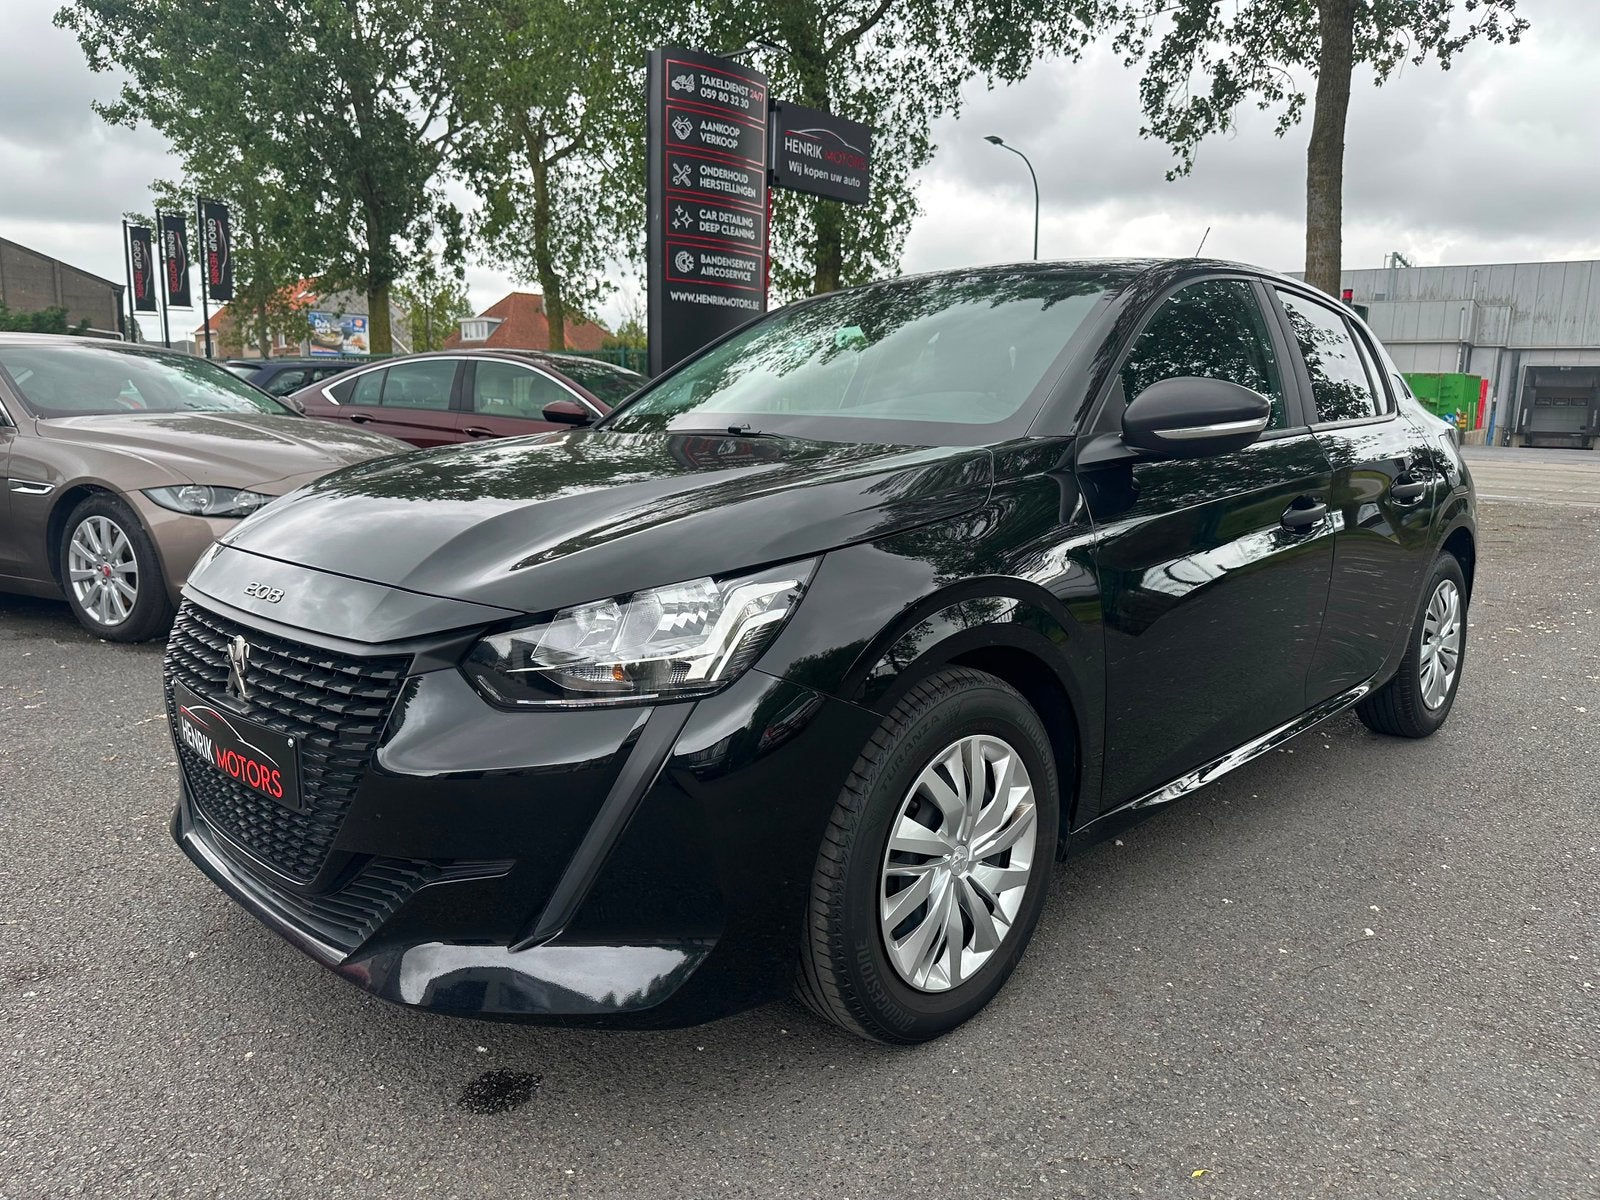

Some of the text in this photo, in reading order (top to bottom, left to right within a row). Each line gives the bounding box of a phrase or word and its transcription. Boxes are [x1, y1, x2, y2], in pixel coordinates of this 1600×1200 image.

[700, 74, 764, 102] TAKELDIENST 24/7
[700, 88, 749, 109] 059 80 32 30
[700, 120, 741, 138] AANKOOP
[700, 132, 738, 149] VERKOOP
[784, 137, 866, 171] HENRIK MOTORS
[700, 165, 749, 184] ONDERHOUD
[788, 160, 861, 188] Wij kopen uw auto
[700, 177, 756, 199] HERSTELLINGEN
[699, 209, 754, 228] CAR DETAILING
[207, 218, 217, 252] GROUP
[700, 222, 755, 241] DEEP CLEANING
[132, 240, 142, 269] GROUP
[166, 230, 178, 293] HENRIK MOTORS
[700, 255, 757, 272] BANDENSERVICE
[700, 266, 751, 281] AIRCOSERVICE
[670, 291, 760, 310] WWW.HENRIKMOTORS.BE
[243, 581, 285, 603] 208
[181, 715, 283, 799] HENRIK MOTORS
[878, 713, 941, 794] TURANZA
